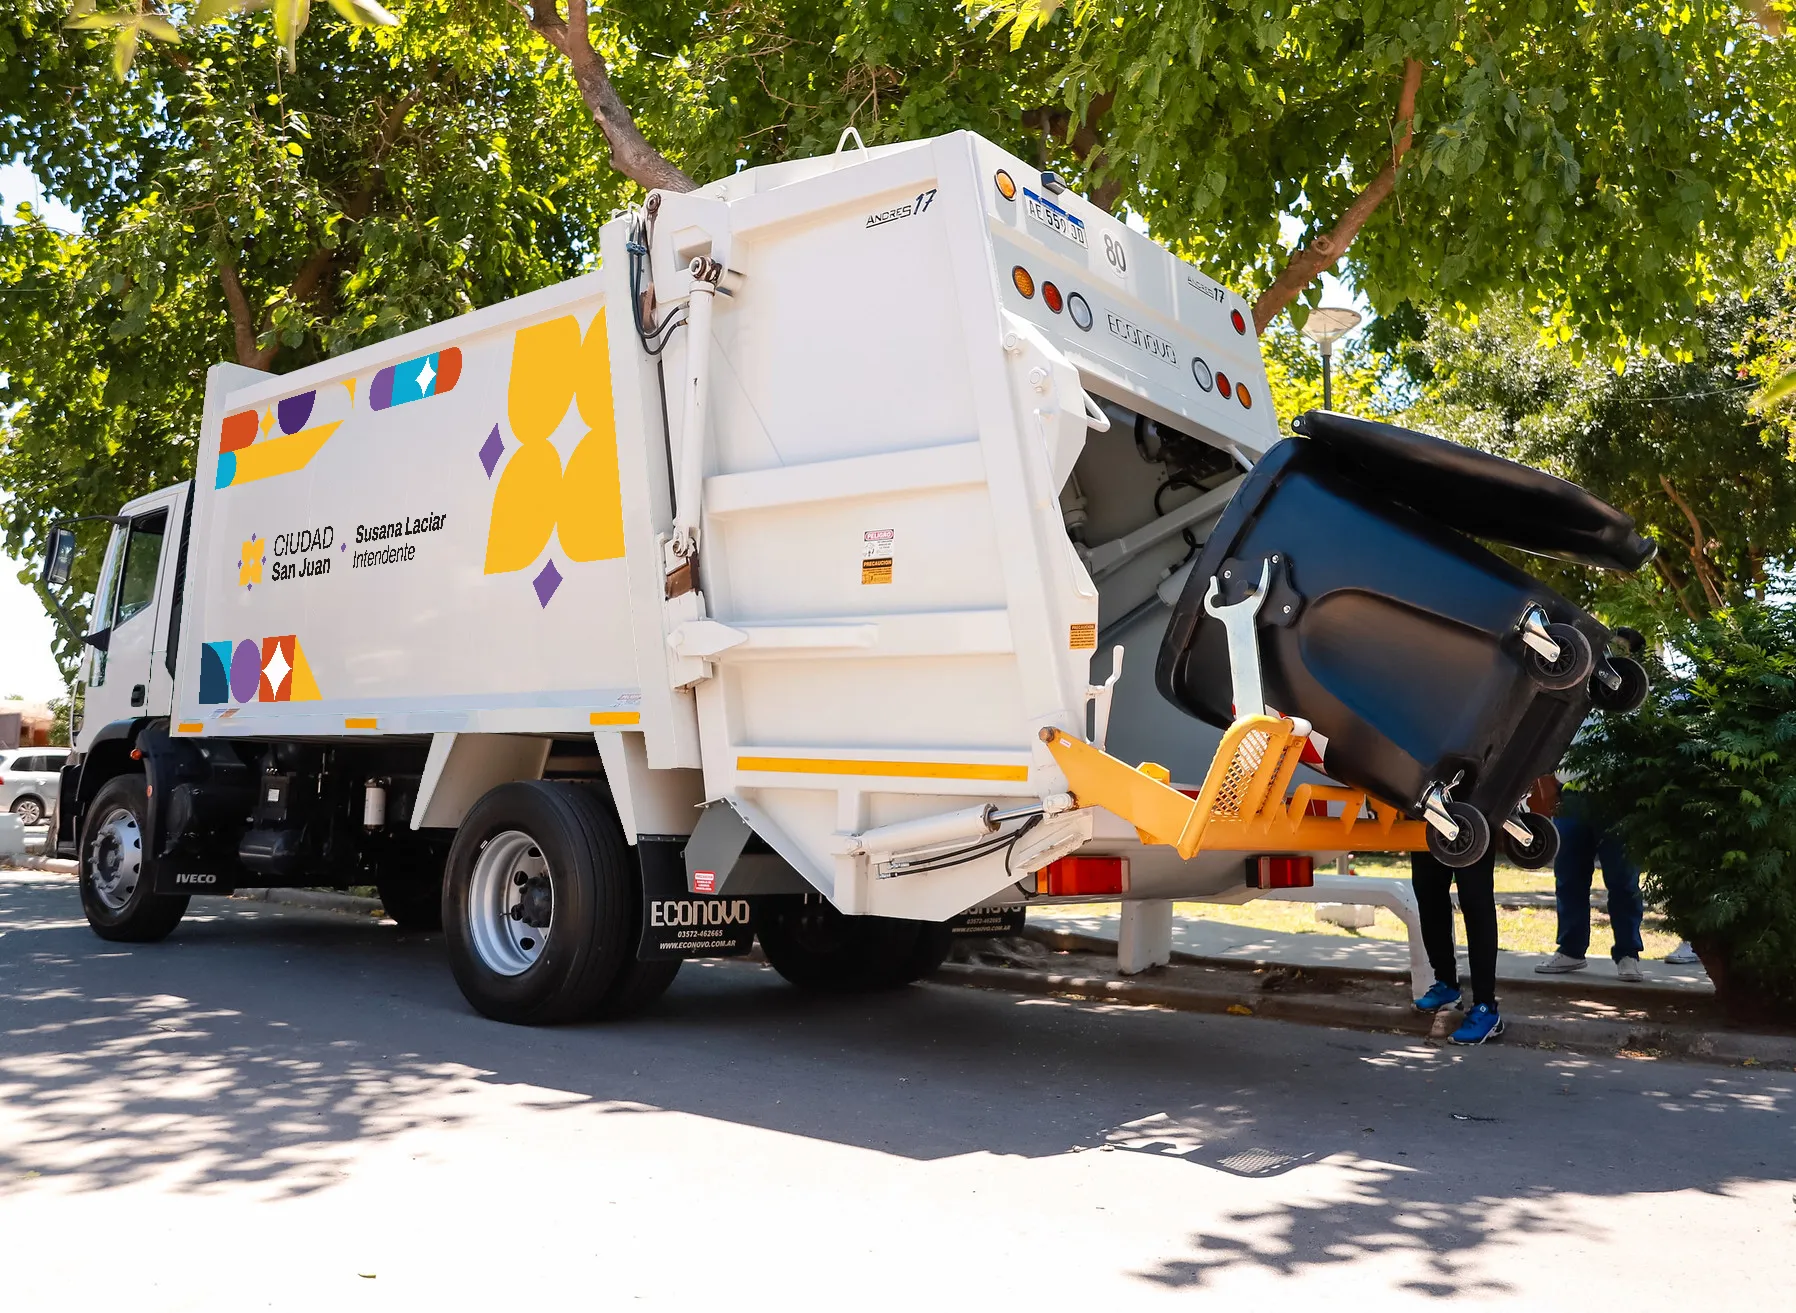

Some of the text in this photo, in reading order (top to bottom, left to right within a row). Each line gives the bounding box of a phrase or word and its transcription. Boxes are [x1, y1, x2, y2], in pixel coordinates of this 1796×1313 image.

[866, 189, 937, 227] ANDRES 17
[1029, 200, 1043, 220] AE
[1104, 233, 1126, 271] 80
[1214, 288, 1224, 303] 17
[355, 512, 446, 543] Susana Laciar
[274, 526, 334, 556] CIUDAD
[353, 543, 415, 569] Intendente
[272, 558, 331, 581] San Juan
[176, 873, 217, 883] IVECO
[651, 900, 750, 926] ECONOVO
[660, 940, 736, 950] WWW.ECONOVO.COM.AR
[677, 930, 723, 938] 03572-462665
